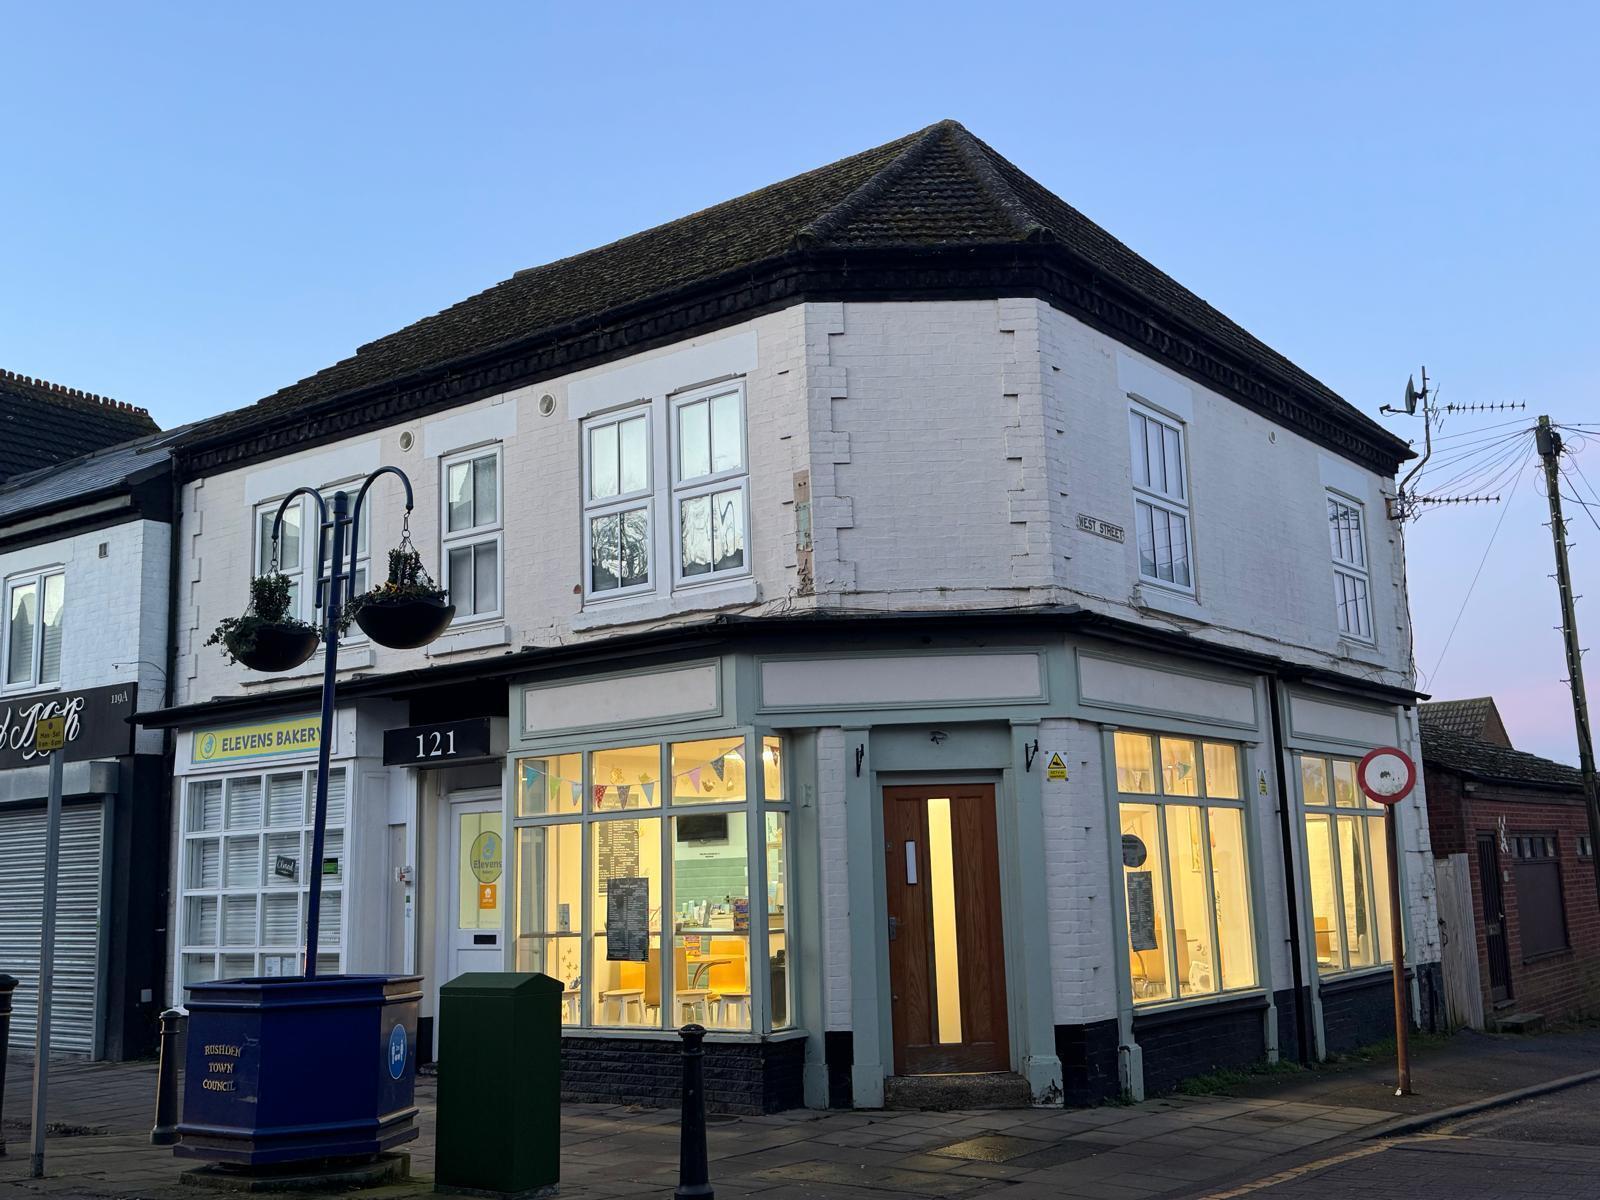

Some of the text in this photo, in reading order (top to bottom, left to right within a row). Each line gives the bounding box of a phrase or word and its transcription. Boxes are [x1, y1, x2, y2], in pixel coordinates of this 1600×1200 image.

[1099, 522, 1124, 541] STREET
[111, 690, 128, 704] 119A
[222, 732, 273, 752] ELEVENS
[416, 730, 456, 758] 121
[204, 1044, 242, 1058] RUSHDEN
[208, 1062, 234, 1074] TOWN
[202, 1078, 236, 1092] COUNCIL
